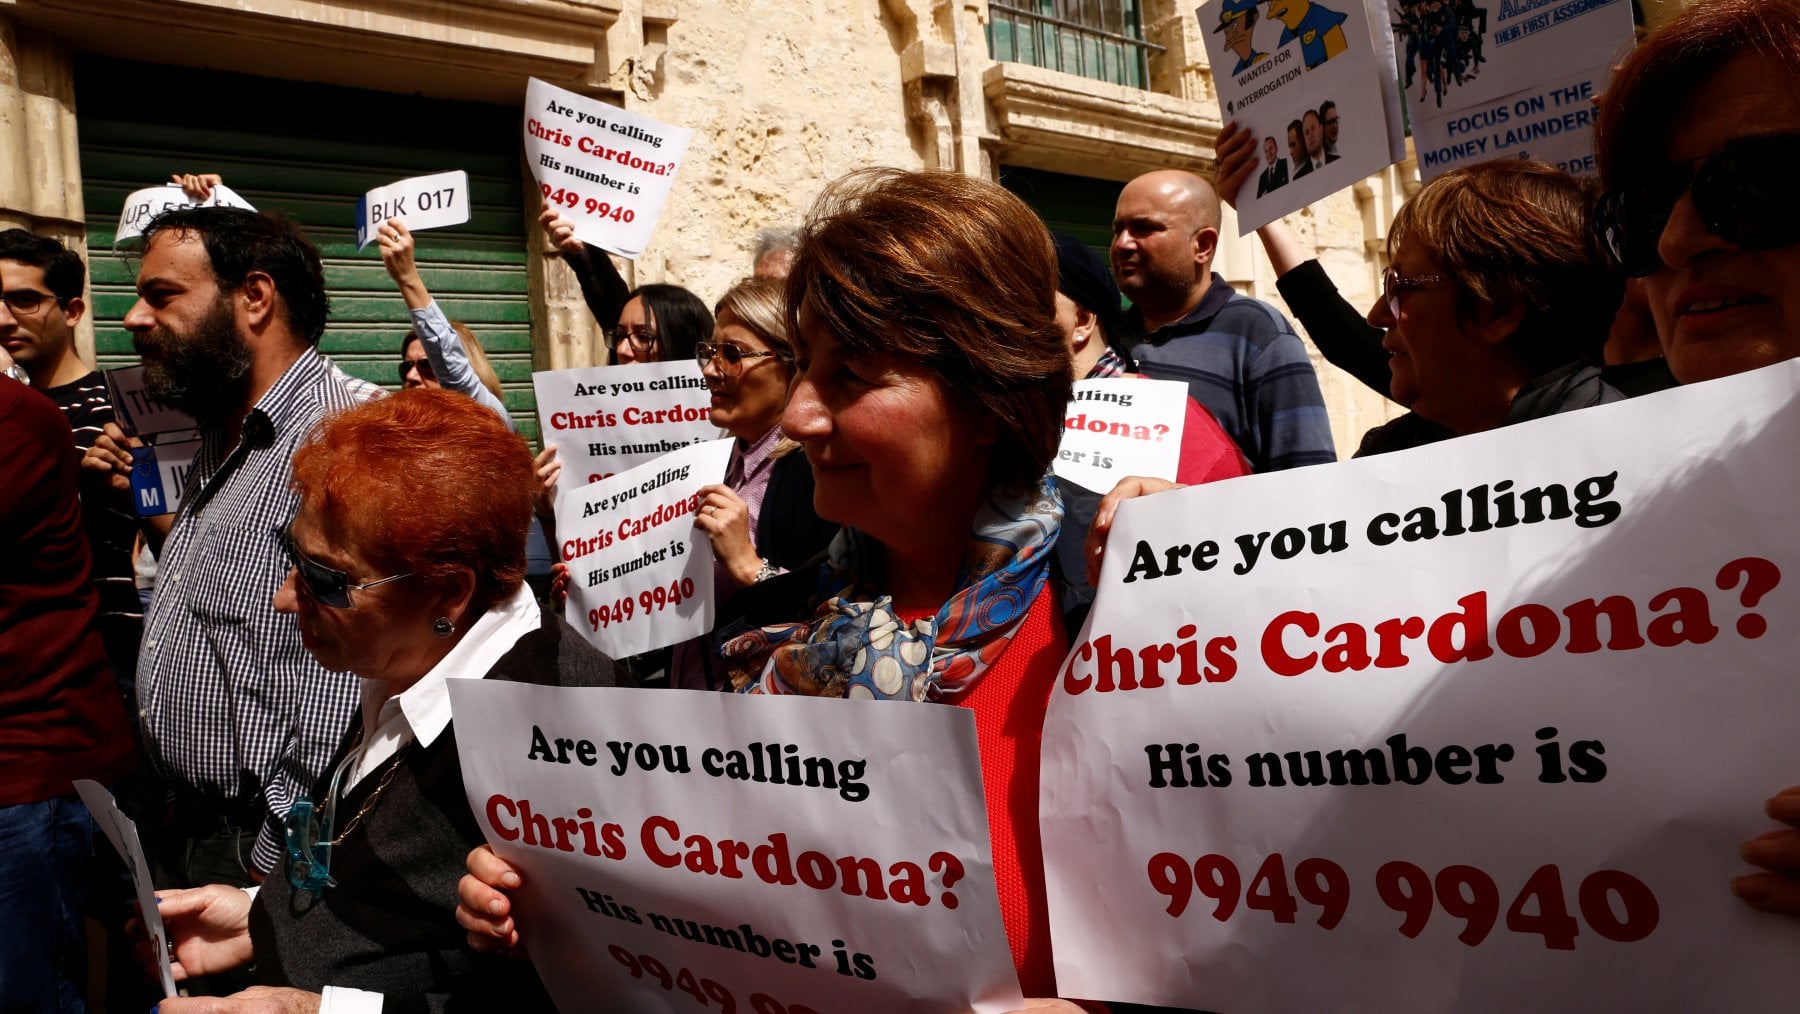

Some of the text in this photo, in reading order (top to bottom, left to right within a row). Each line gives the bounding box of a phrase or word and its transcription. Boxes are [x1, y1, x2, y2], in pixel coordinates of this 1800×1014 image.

[1494, 26, 1521, 45] THEIR
[1523, 15, 1551, 36] FIRST
[1235, 66, 1302, 111] INTERROGATION
[1237, 49, 1292, 88] WANTED FOR
[546, 100, 663, 148] Are you calling
[1446, 81, 1593, 137] FOCUS ON THE
[527, 118, 675, 177] Chris Cardona?
[1423, 137, 1488, 169] MONEY
[539, 153, 641, 195] His number is
[372, 196, 408, 225] BLK
[584, 198, 635, 223] 9940
[574, 376, 709, 397] Are you calling
[550, 410, 617, 430] Chris
[588, 443, 617, 457] His
[1091, 451, 1114, 469] is
[140, 487, 159, 507] M
[582, 501, 609, 518] Are
[611, 488, 638, 510] you
[640, 464, 691, 494] calling
[562, 490, 701, 562] Chris Cardona
[1123, 470, 1621, 583] Are you calling
[588, 540, 685, 588] His number is
[588, 577, 695, 632] 9949 9940
[1063, 557, 1781, 696] Chris Cardona?
[527, 724, 870, 802] Are you calling
[1144, 726, 1607, 788] His number is
[486, 794, 965, 910] Chris Cardona?
[1147, 852, 1660, 950] 9949 9940
[575, 887, 877, 980] His number is
[607, 944, 737, 1014] 9949
